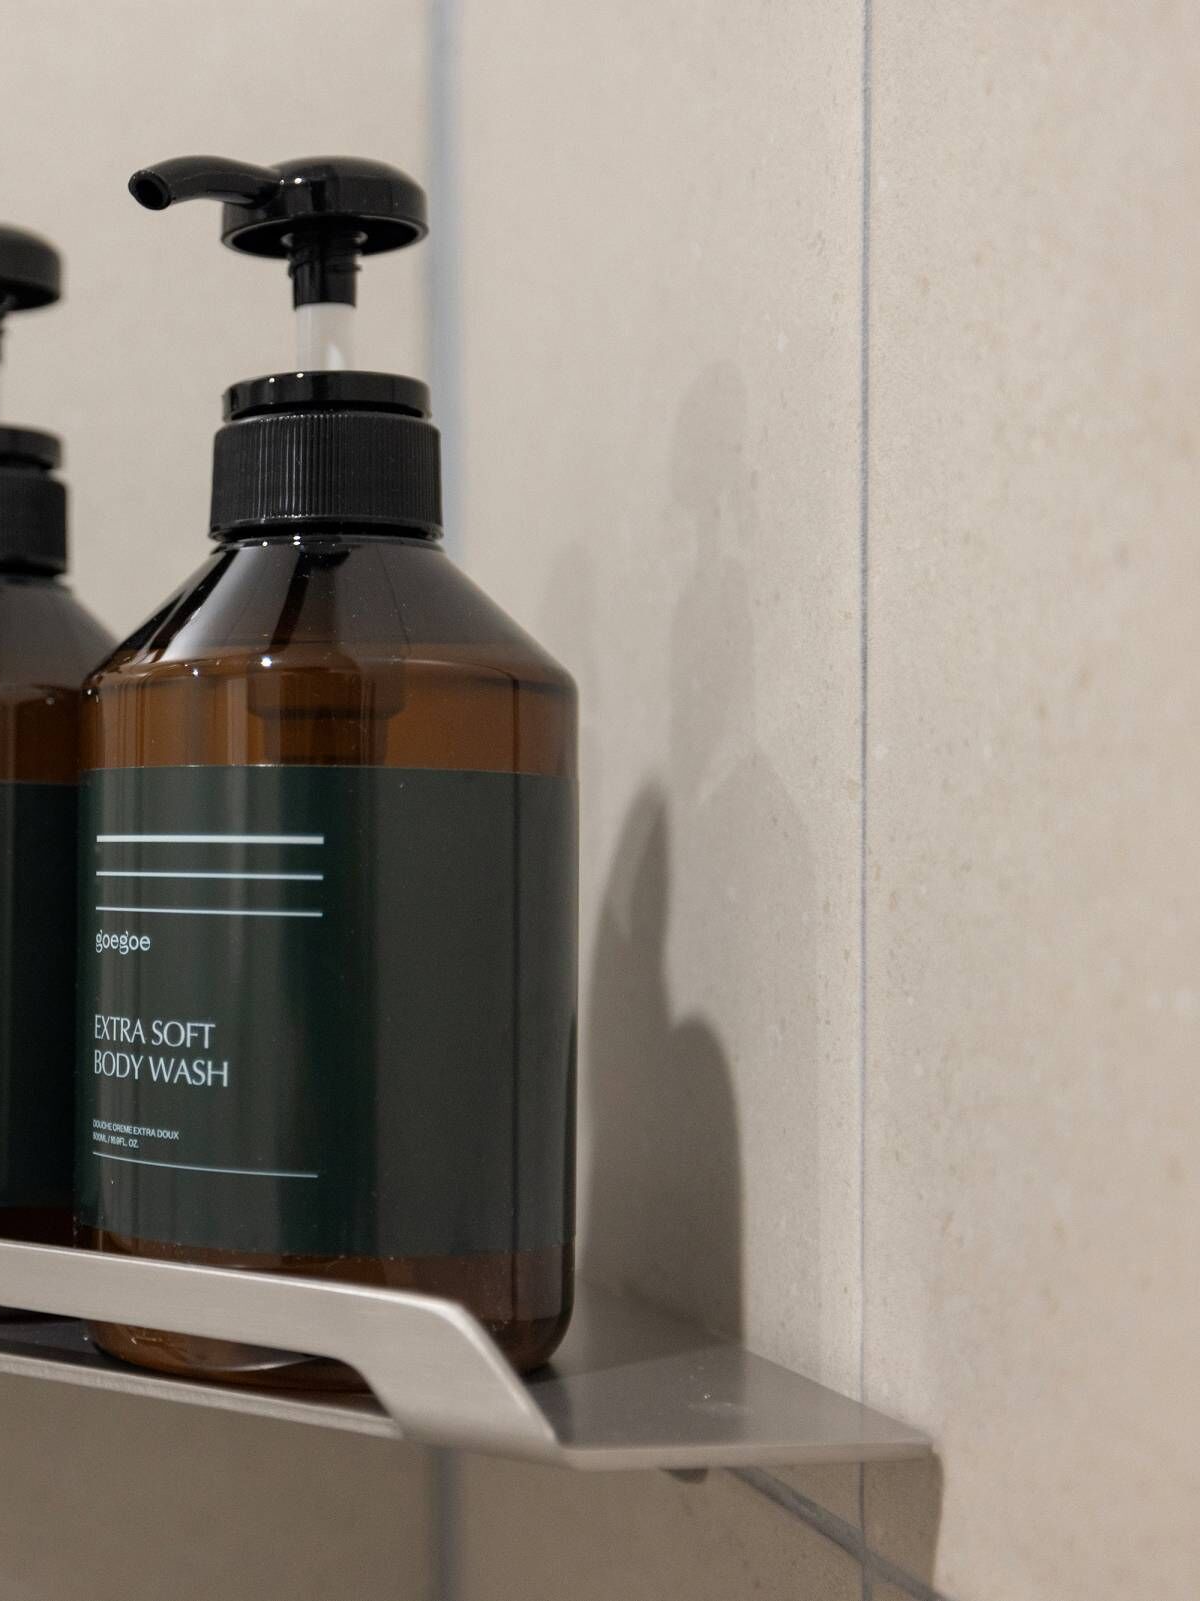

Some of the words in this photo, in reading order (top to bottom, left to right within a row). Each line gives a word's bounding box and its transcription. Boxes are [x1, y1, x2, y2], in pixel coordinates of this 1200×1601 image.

[95, 929, 151, 955] goegoe
[94, 1014, 146, 1044] EXTRA
[151, 1020, 216, 1049] SOFT
[94, 1049, 143, 1080] BODY
[148, 1056, 229, 1087] WASH
[133, 1126, 156, 1138] EXTRA
[157, 1129, 179, 1140] DOUX
